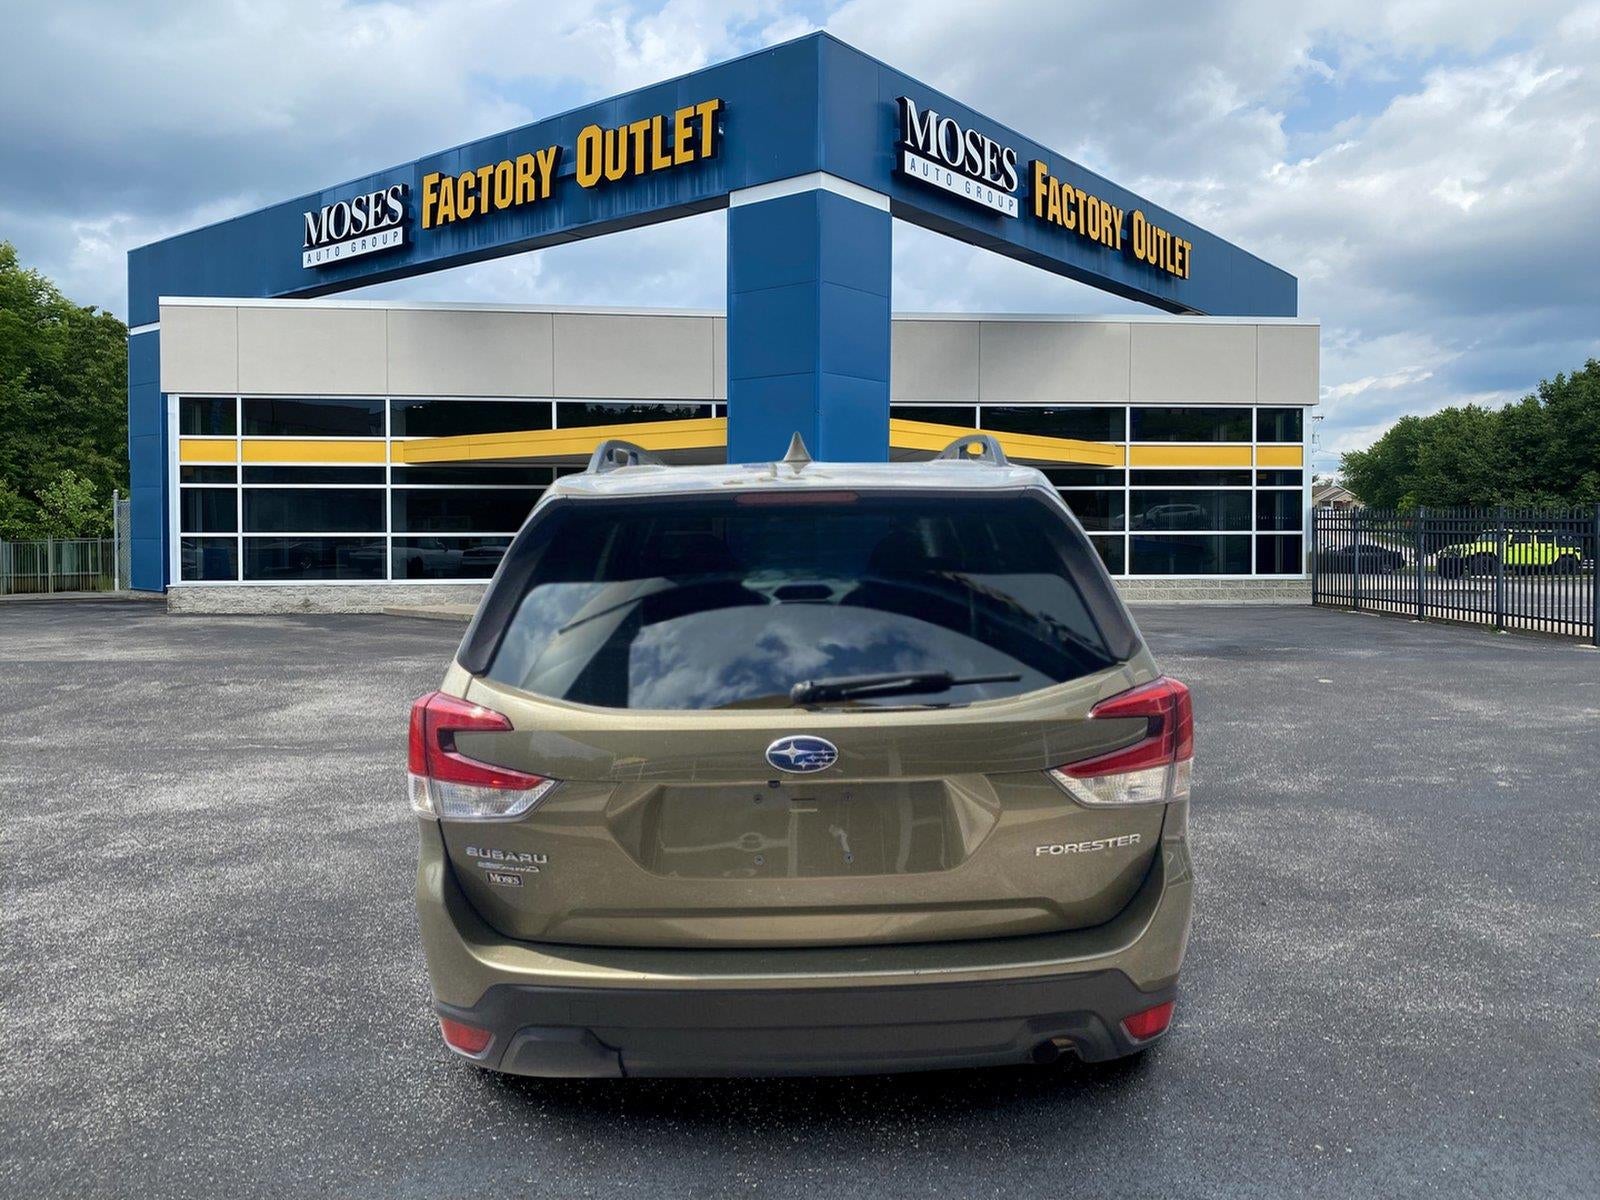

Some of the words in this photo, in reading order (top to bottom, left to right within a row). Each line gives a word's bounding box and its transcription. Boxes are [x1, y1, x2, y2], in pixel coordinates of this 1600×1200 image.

[422, 145, 558, 229] FACTORY
[576, 98, 719, 188] OUTLET
[904, 96, 1018, 192] MOSES
[910, 157, 952, 187] AUTO
[965, 180, 1014, 211] GROUP
[303, 184, 403, 247] MOSES
[1034, 160, 1123, 250] FACTORY
[1132, 209, 1192, 279] OUTLET
[307, 246, 340, 264] AUTO
[351, 231, 398, 253] GROUP
[466, 846, 547, 864] SUBARU
[1035, 833, 1141, 856] FORESTER
